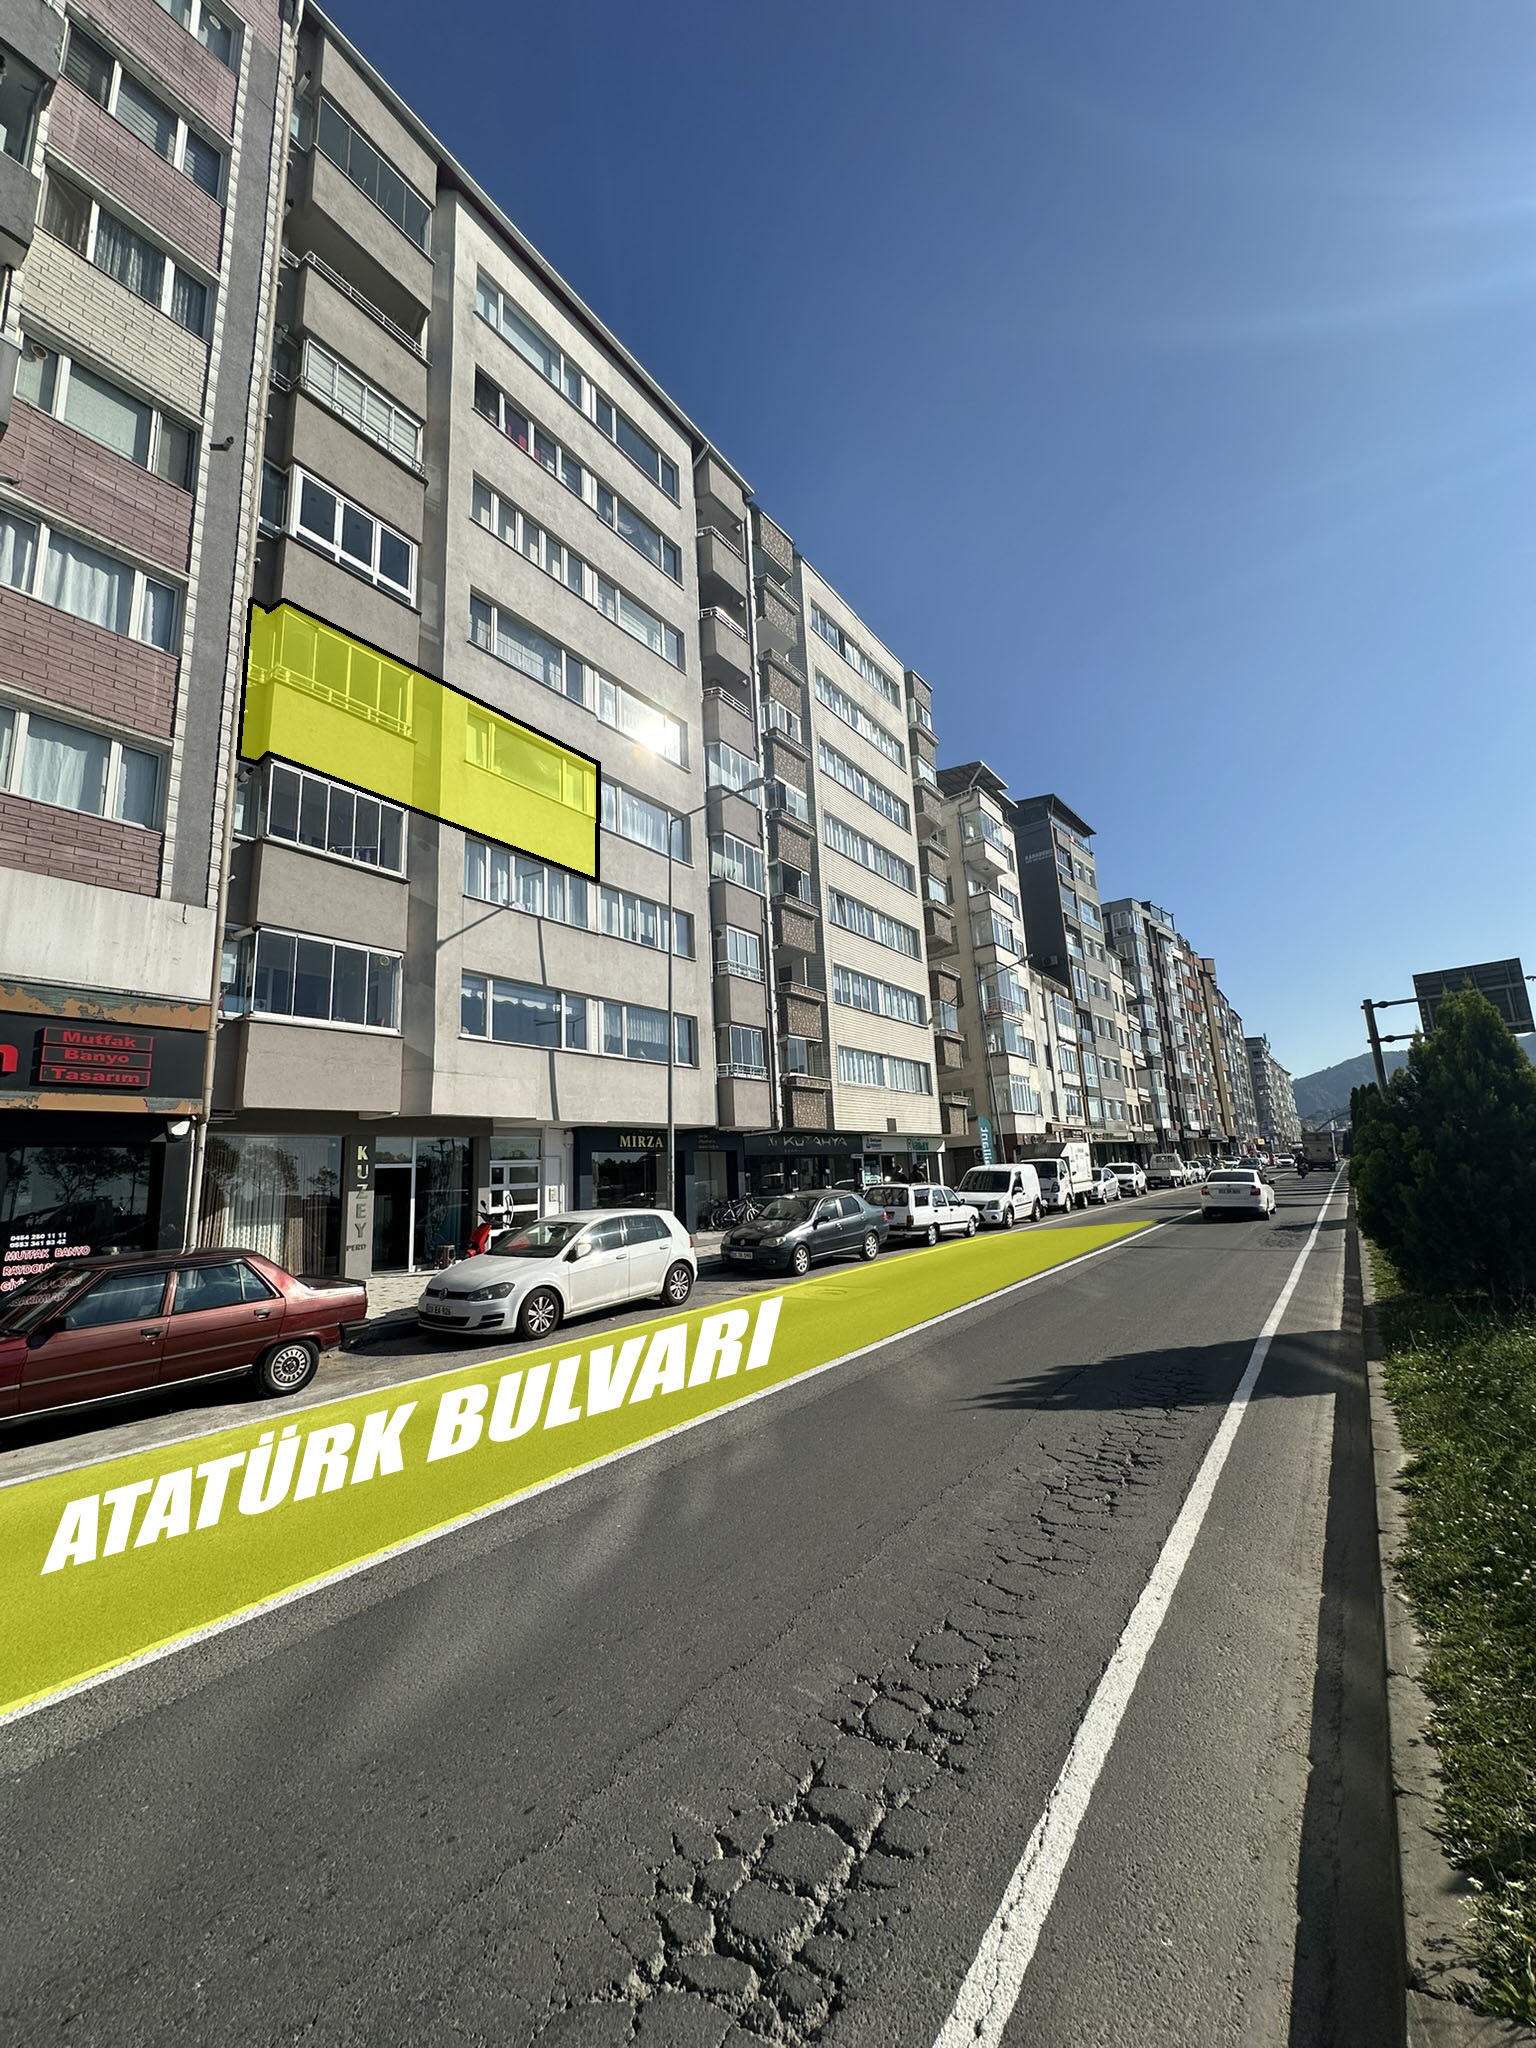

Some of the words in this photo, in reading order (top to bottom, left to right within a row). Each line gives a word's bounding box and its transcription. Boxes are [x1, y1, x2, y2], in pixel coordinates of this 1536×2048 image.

[63, 1031, 136, 1047] Mutfak
[64, 1048, 130, 1065] Banyo
[51, 1068, 140, 1083] Tasarım
[619, 1135, 664, 1148] MIRZA
[354, 1145, 369, 1238] KUZEY
[4, 1248, 50, 1262] MUTFAK
[54, 1245, 91, 1258] BANYO
